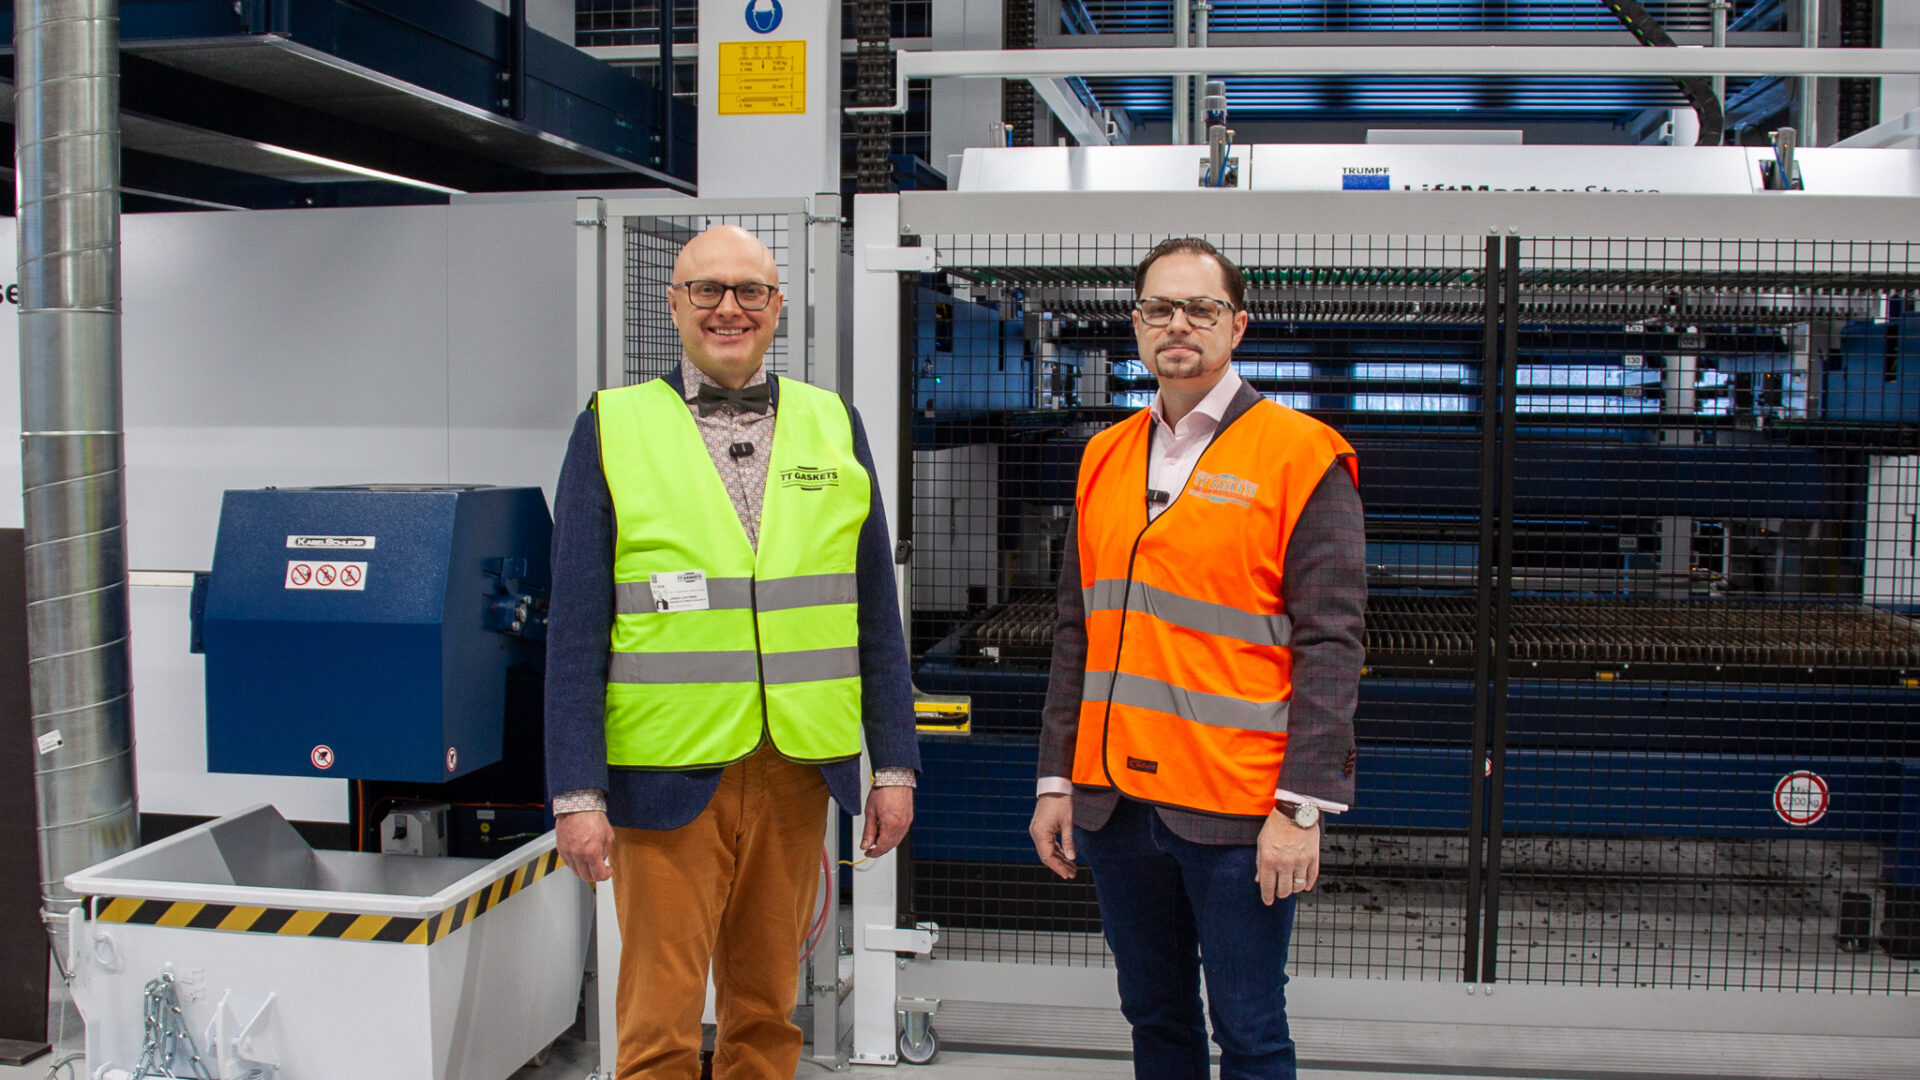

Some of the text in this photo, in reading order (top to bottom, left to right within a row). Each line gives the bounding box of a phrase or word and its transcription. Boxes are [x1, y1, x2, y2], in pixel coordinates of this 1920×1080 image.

[0, 284, 18, 304] e
[781, 471, 838, 481] TT GASKETS
[1208, 479, 1257, 497] GASKETS
